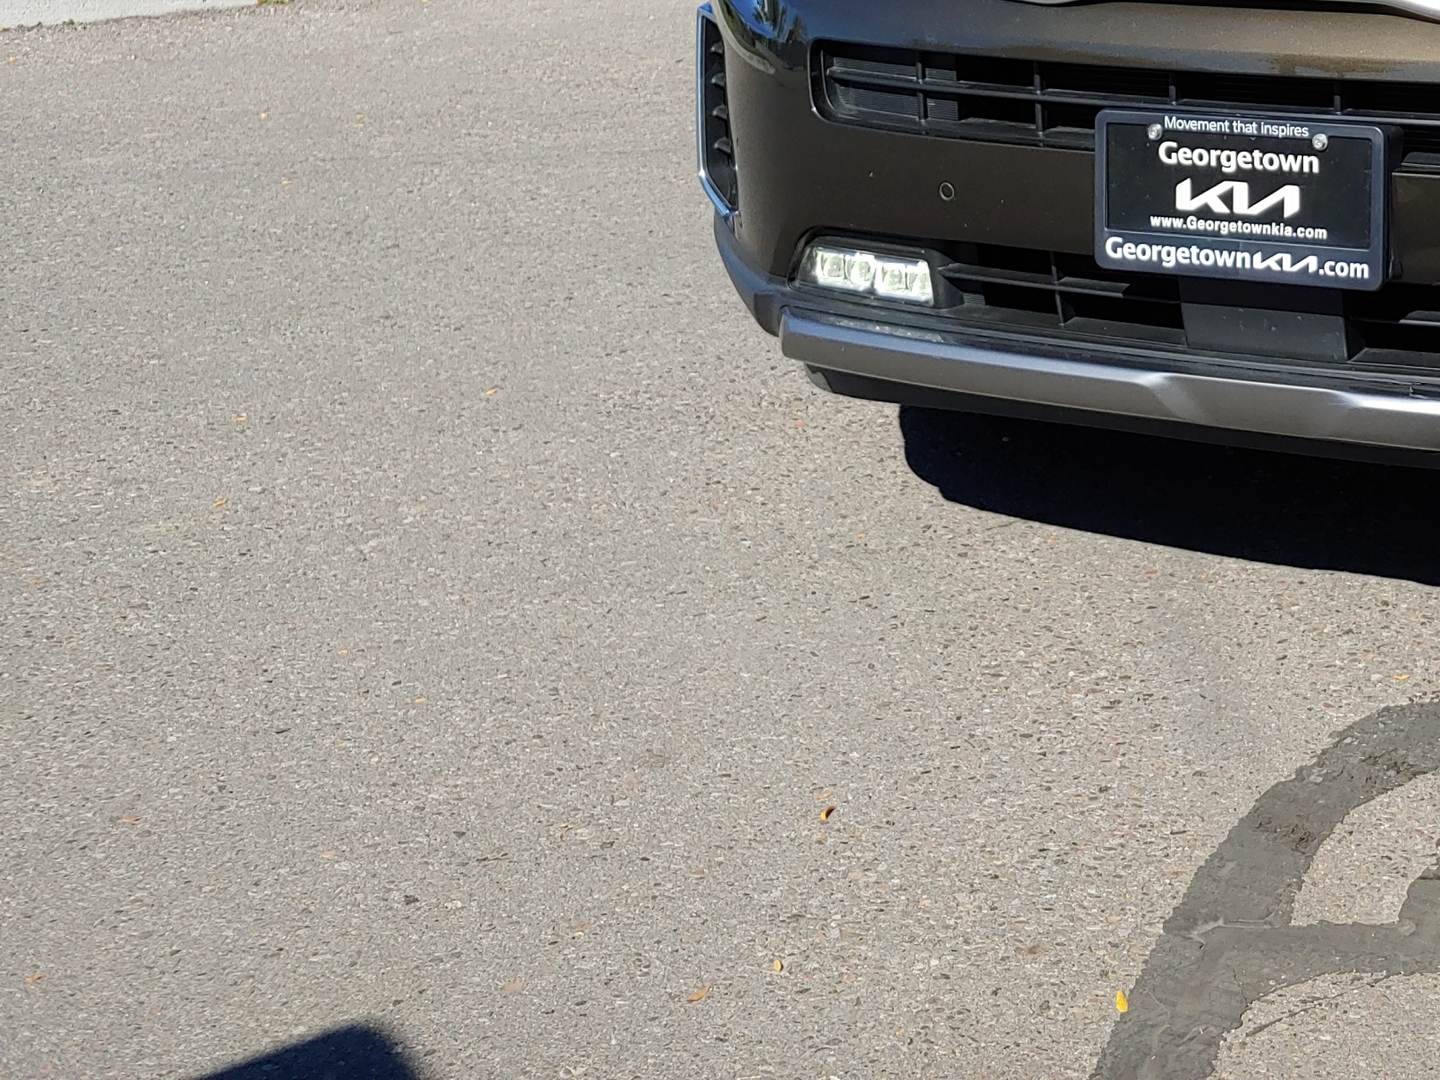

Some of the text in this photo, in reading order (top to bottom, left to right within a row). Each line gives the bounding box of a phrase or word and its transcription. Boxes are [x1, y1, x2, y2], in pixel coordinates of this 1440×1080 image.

[1164, 115, 1309, 138] Movement that inspires
[1158, 141, 1320, 173] Georgetown
[1175, 177, 1300, 219] KIA
[1149, 215, 1328, 240] www.Georgetownkia.com
